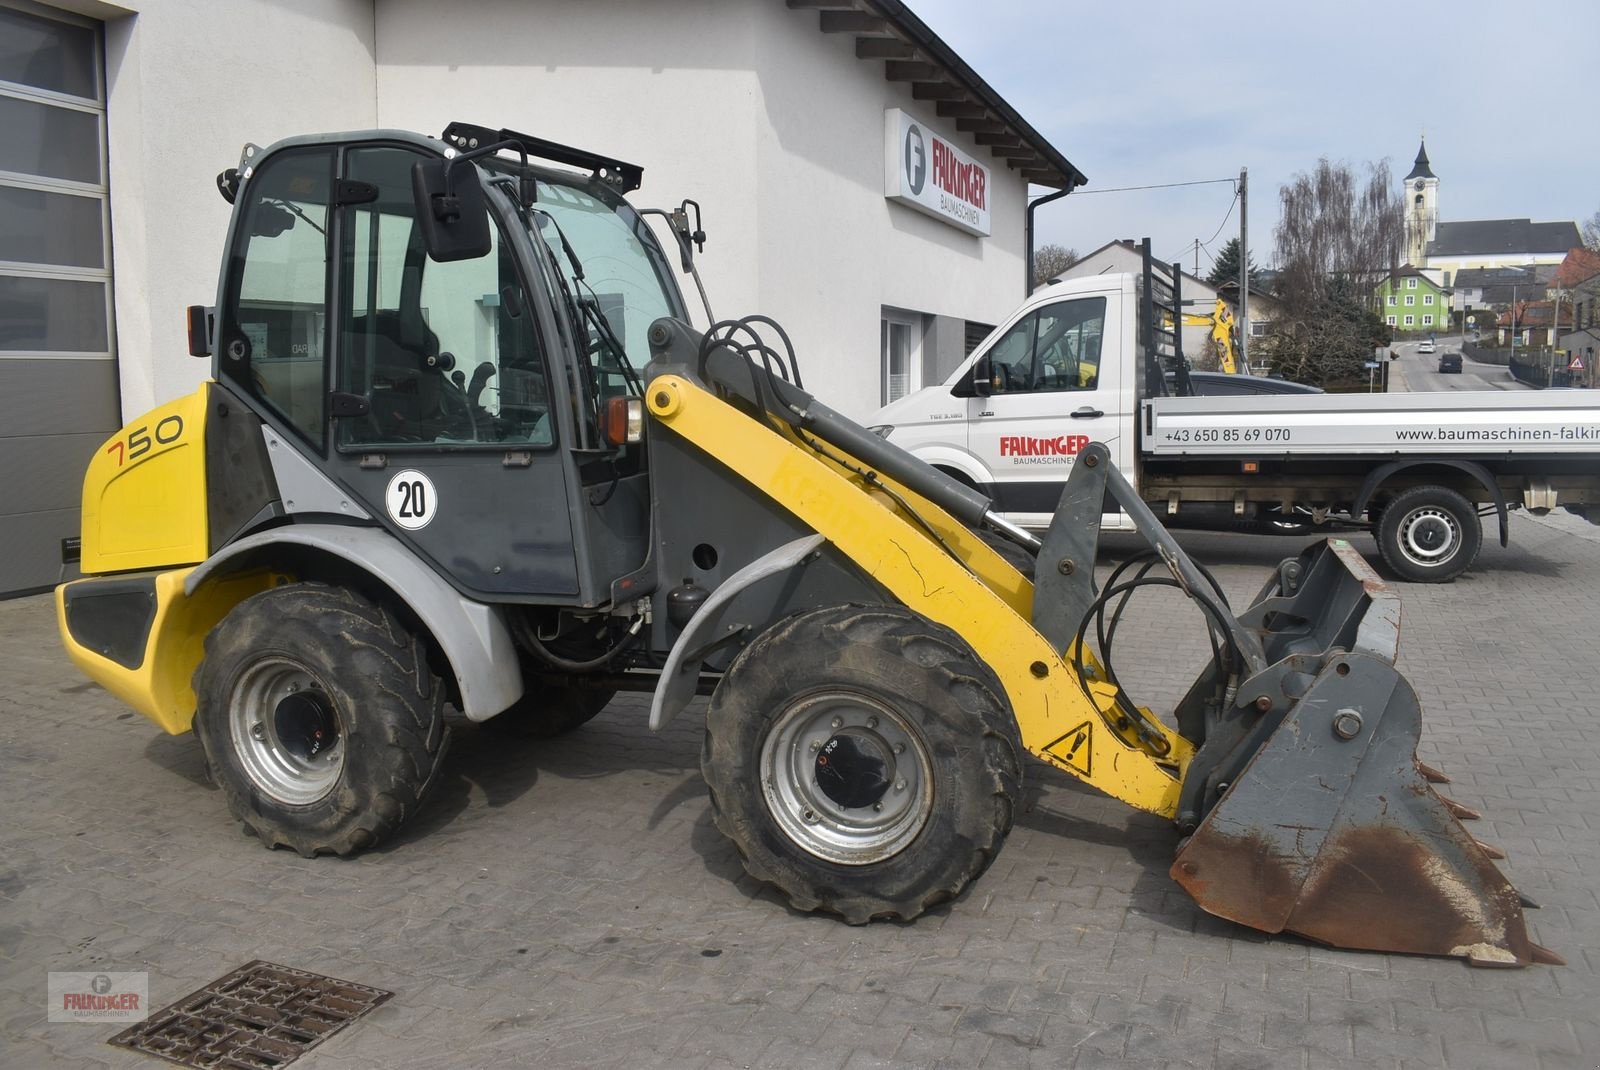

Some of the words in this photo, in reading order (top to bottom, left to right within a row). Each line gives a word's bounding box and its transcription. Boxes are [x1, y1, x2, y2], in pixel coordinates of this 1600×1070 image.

[932, 137, 986, 211] FALKINGER
[940, 194, 980, 225] BAUMASCHINEN
[107, 415, 184, 467] 750
[1000, 434, 1090, 457] FALKINGER
[1165, 430, 1190, 441] +43
[1194, 430, 1219, 441] 650
[1223, 429, 1240, 441] 85
[1244, 429, 1261, 441] 69
[1265, 429, 1290, 441] 070
[398, 480, 426, 517] 20
